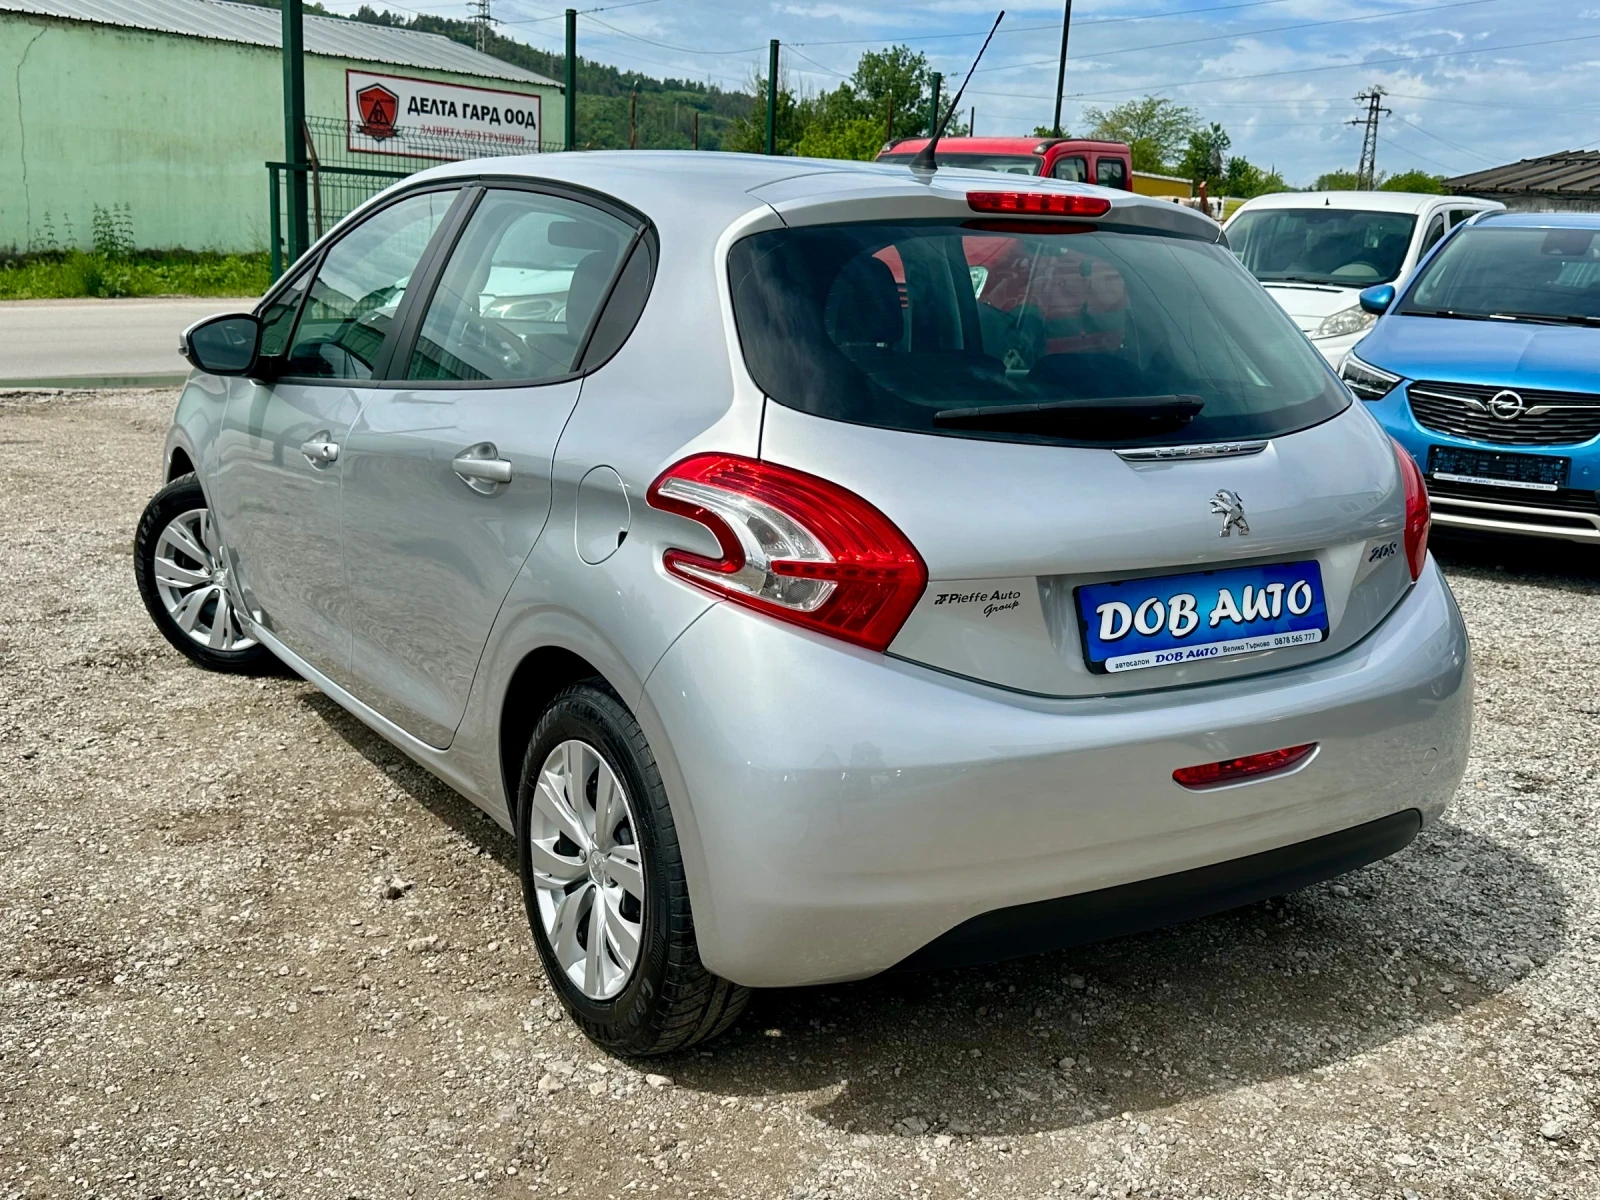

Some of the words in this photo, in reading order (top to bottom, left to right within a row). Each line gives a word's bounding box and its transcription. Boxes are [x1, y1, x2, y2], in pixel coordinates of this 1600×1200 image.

[407, 96, 458, 118] ДЕЛТА
[462, 103, 501, 126] ГАРД
[504, 108, 536, 130] ООД
[1368, 541, 1398, 562] 208
[948, 592, 988, 604] Pieffe
[990, 590, 1021, 601] Auto
[983, 600, 1020, 618] Group
[1096, 593, 1200, 641] DOB
[1209, 579, 1313, 627] AUTO
[1115, 658, 1150, 669] автосалон
[1155, 651, 1184, 663] DOB
[1186, 647, 1219, 659] AUTO
[1222, 644, 1245, 653] Велико
[1274, 636, 1291, 646] 0878
[1291, 634, 1304, 643] 565
[1304, 632, 1316, 641] 777
